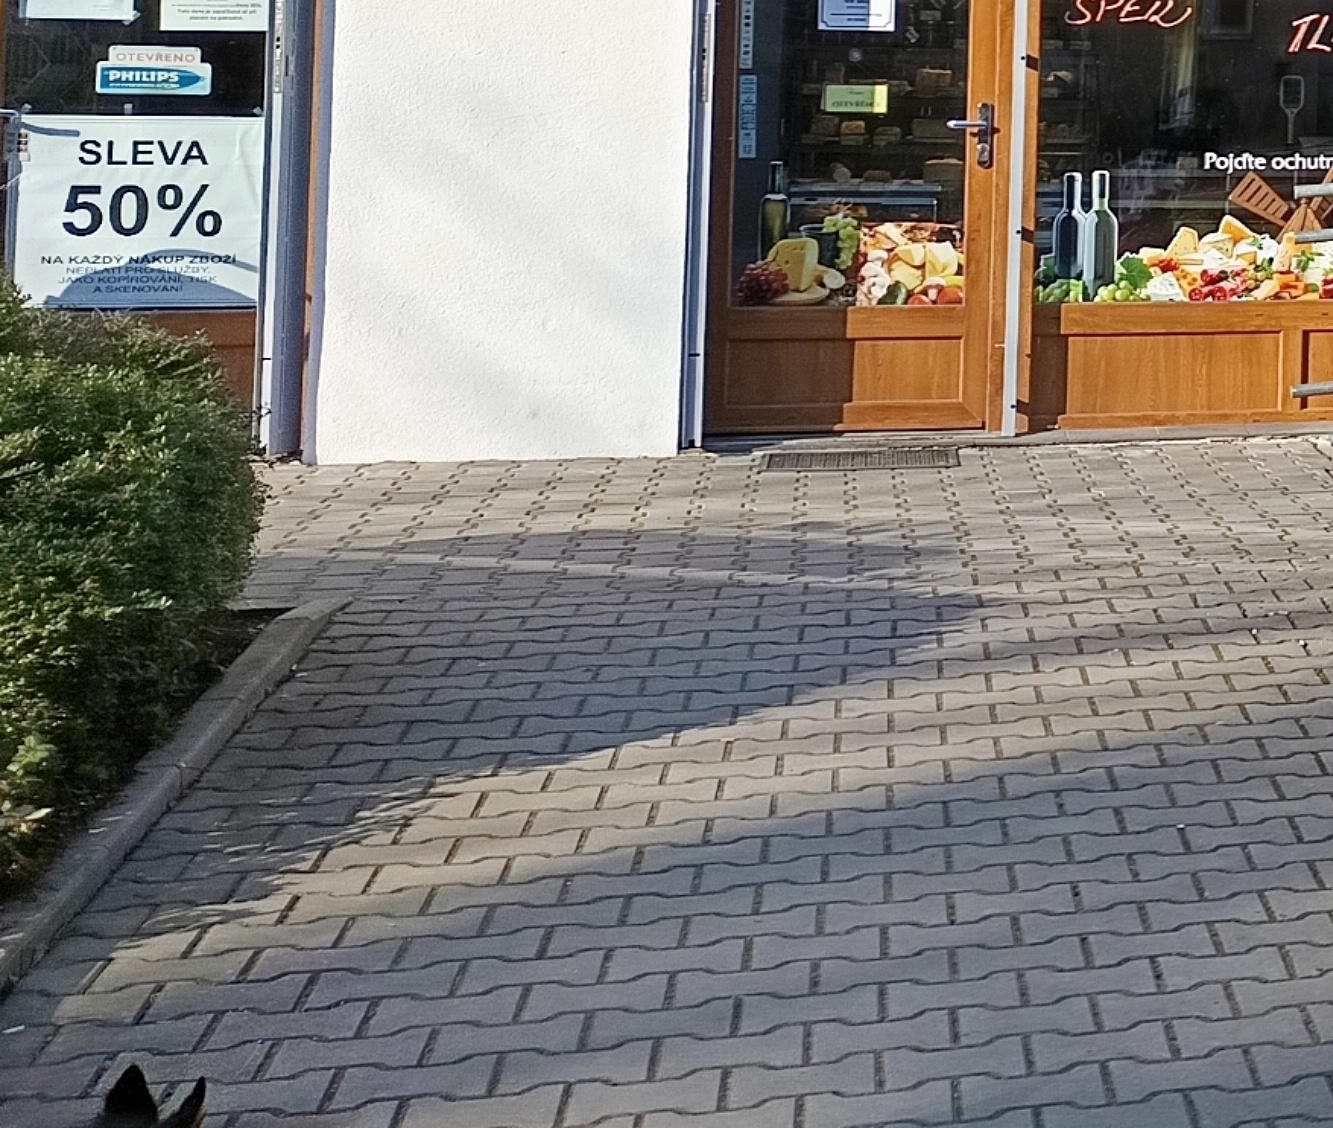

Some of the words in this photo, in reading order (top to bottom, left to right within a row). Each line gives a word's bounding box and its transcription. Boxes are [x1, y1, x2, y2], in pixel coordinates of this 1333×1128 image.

[115, 52, 196, 63] OTEVŘENO
[108, 70, 180, 82] PHILIPS
[78, 139, 208, 166] SLEVA
[1203, 151, 1267, 175] Pojďte
[62, 183, 223, 237] 50%
[40, 255, 64, 265] NA
[68, 254, 124, 265] KAŽDÝ
[128, 254, 185, 265] NÁKUP
